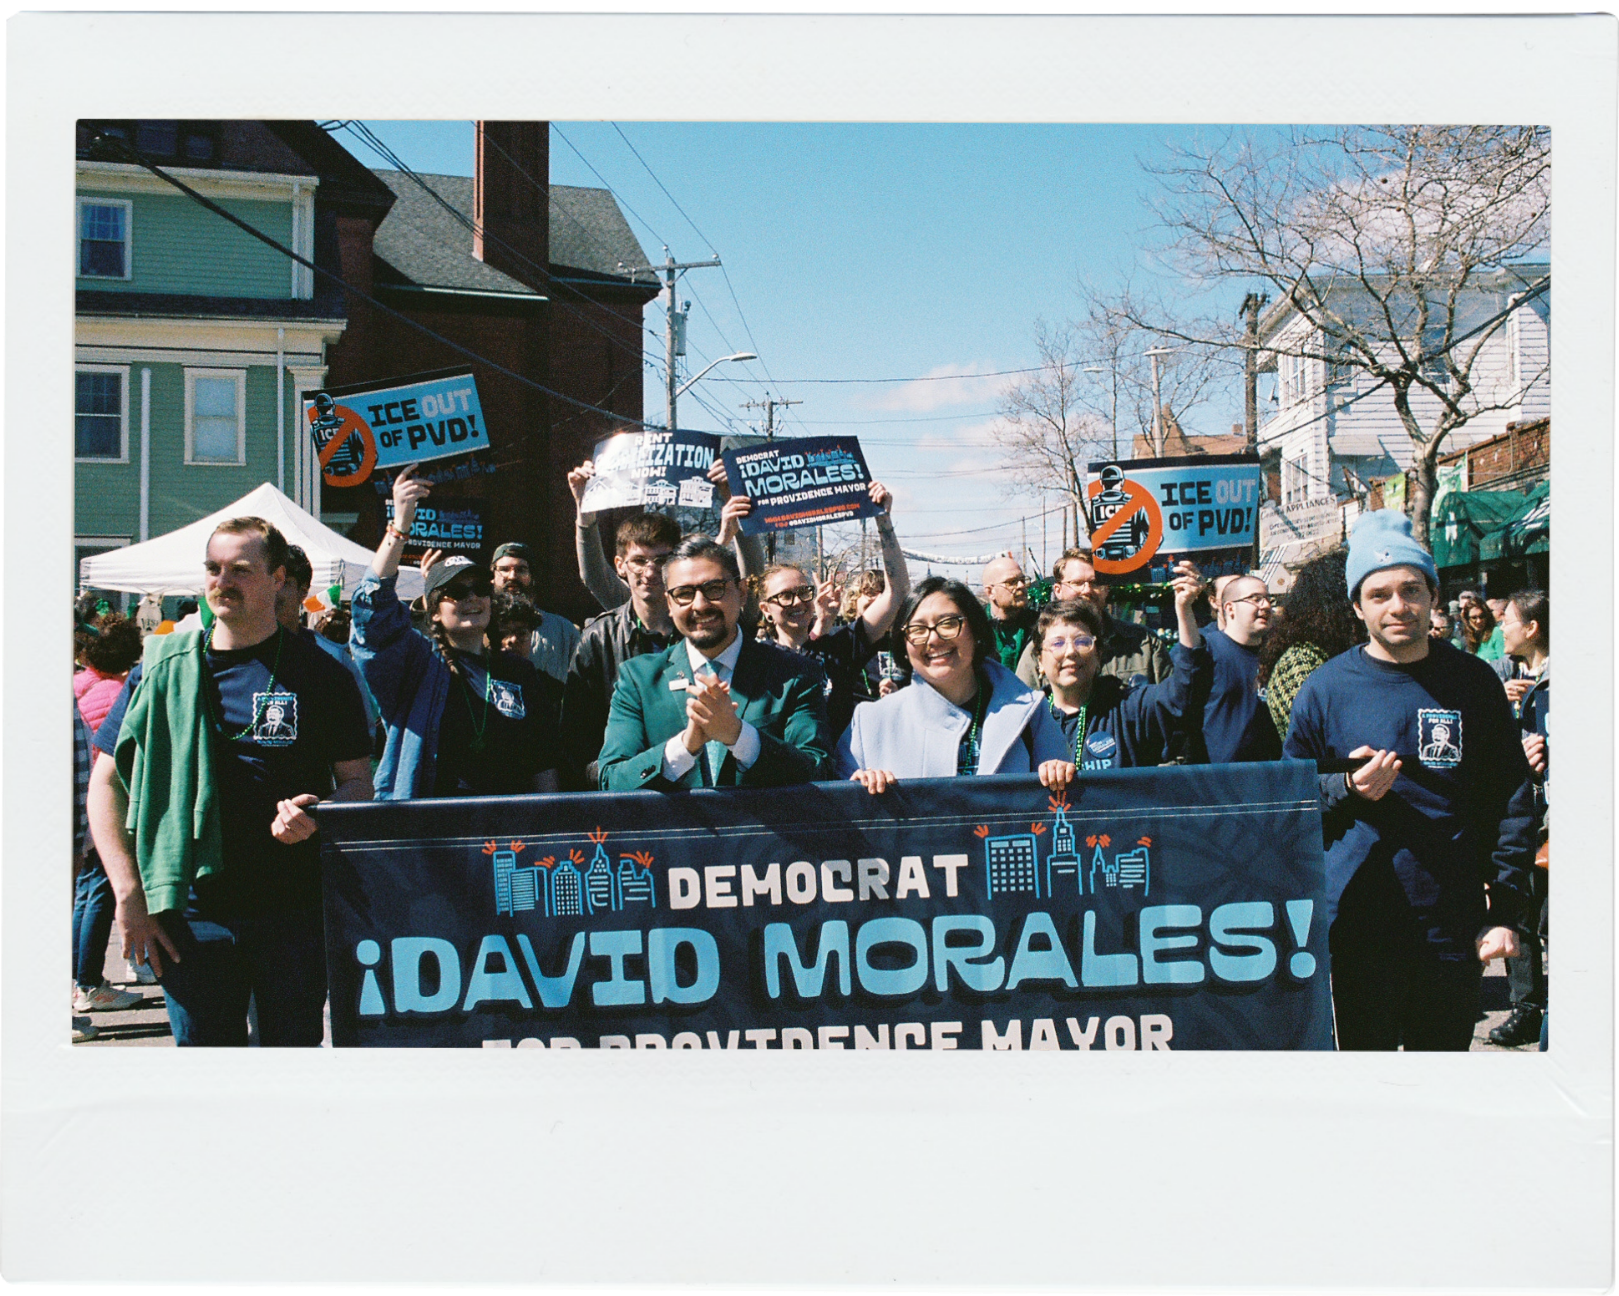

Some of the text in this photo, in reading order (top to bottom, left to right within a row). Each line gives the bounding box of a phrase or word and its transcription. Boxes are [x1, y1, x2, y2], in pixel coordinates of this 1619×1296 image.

[368, 388, 472, 427] ICE OUT
[380, 414, 479, 450] OF PVD!
[634, 432, 673, 447] RENT
[736, 449, 779, 465] DEMOCRAT
[739, 454, 804, 479] ¡DAVID
[631, 466, 666, 479] NOW!
[744, 463, 864, 498] MORALES!
[757, 482, 866, 506] FOR PROVIDENCE MAYOR
[1160, 478, 1256, 507] ICE OUT
[1286, 496, 1335, 513] APPLIANCES
[409, 522, 483, 539] RALES!
[1169, 512, 1194, 531] OF
[1198, 507, 1253, 536] PVD!
[408, 539, 481, 549] ROVIDENCE MAYOR
[1081, 759, 1112, 770] HIP
[668, 853, 969, 910] DEMOCRAT
[356, 899, 1316, 1015] ¡DAVID MORALES!
[980, 1013, 1173, 1050] MAYOR
